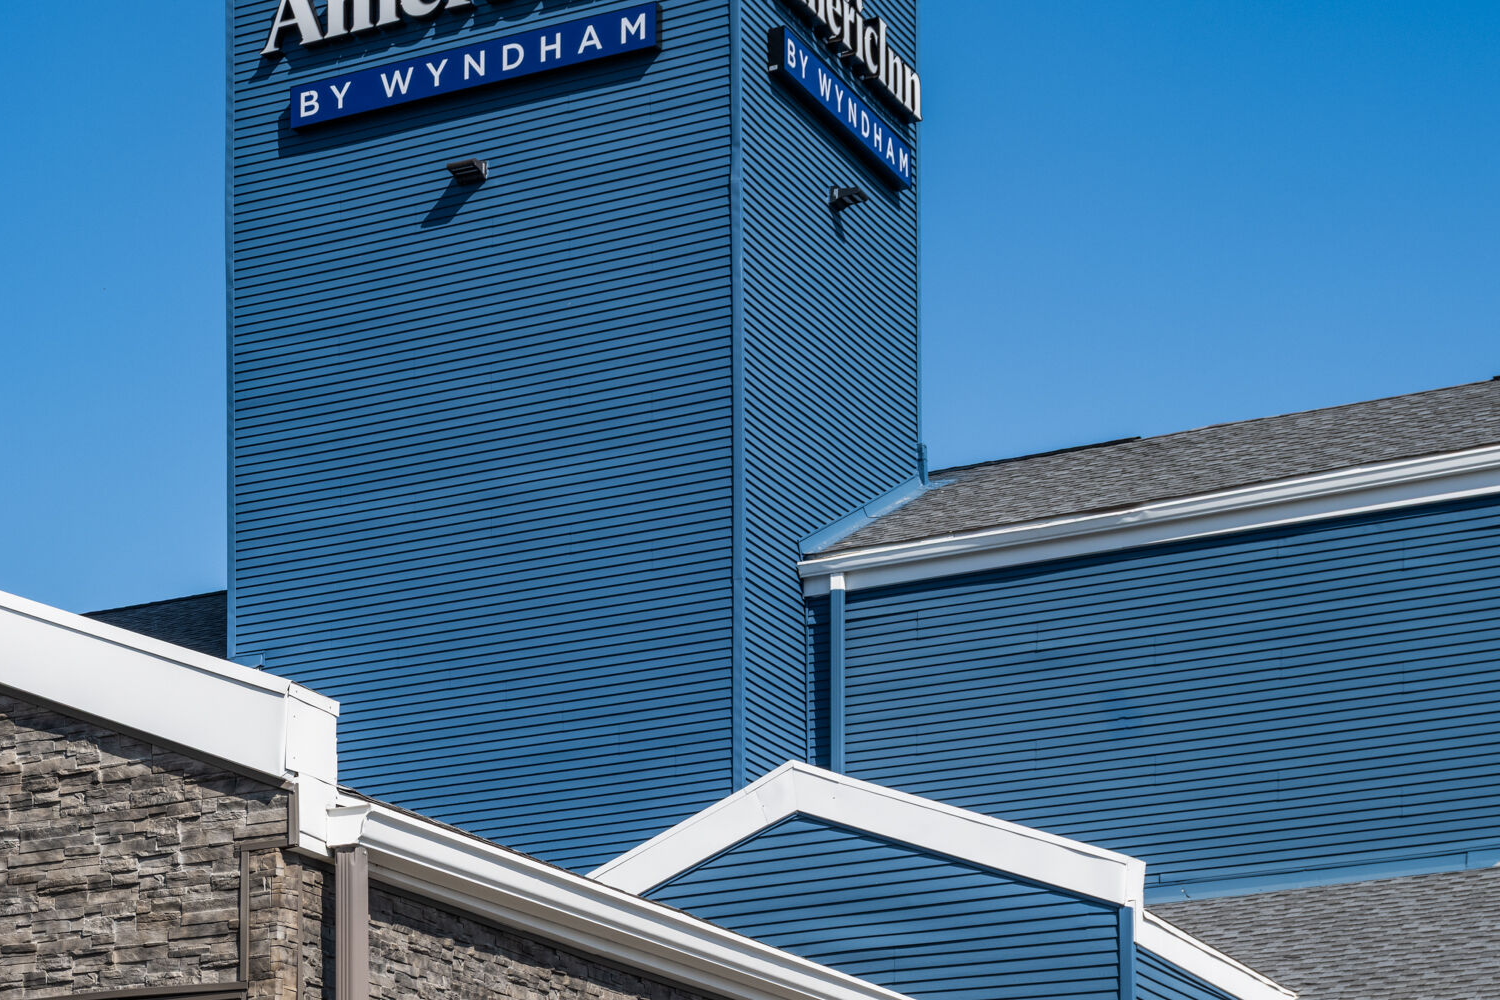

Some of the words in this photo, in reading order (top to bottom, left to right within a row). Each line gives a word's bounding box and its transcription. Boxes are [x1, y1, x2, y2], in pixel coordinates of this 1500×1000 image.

[299, 81, 351, 118] BY
[380, 13, 647, 98] WYNDHAM
[787, 38, 808, 79] BY
[818, 67, 909, 178] WYNDHAM
